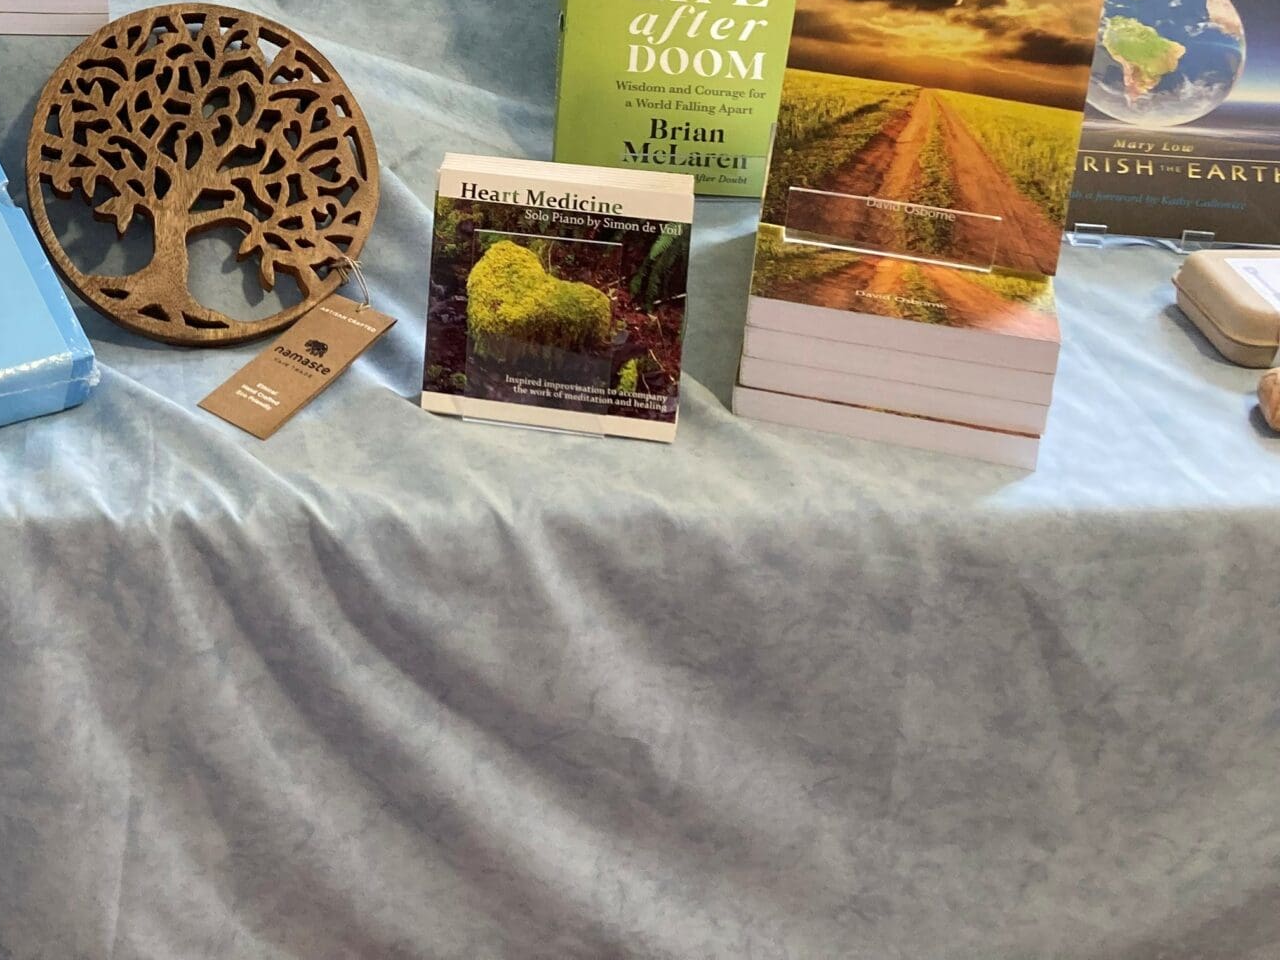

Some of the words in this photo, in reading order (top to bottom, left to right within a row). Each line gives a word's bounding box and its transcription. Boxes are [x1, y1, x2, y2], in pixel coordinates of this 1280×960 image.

[629, 5, 768, 45] after
[627, 45, 766, 80] DOOM
[616, 81, 666, 94] Wisdom
[669, 85, 691, 95] and
[694, 85, 746, 100] Courage
[749, 88, 766, 99] for
[635, 98, 672, 110] World
[675, 100, 716, 115] Falling
[719, 104, 753, 116] Apart
[649, 118, 725, 143] Brian
[622, 141, 747, 169] McLaren
[1114, 139, 1155, 152] Mary
[1162, 142, 1195, 152] Low
[1083, 156, 1153, 175] RISH
[1160, 165, 1181, 173] THE
[461, 182, 520, 205] Heart
[526, 190, 623, 214] Medicine
[525, 210, 549, 222] Solo
[552, 213, 584, 225] Piano
[587, 217, 600, 230] by
[603, 218, 639, 230] Simon
[642, 222, 655, 233] de
[658, 223, 682, 235] Voil
[274, 346, 331, 375] namaste
